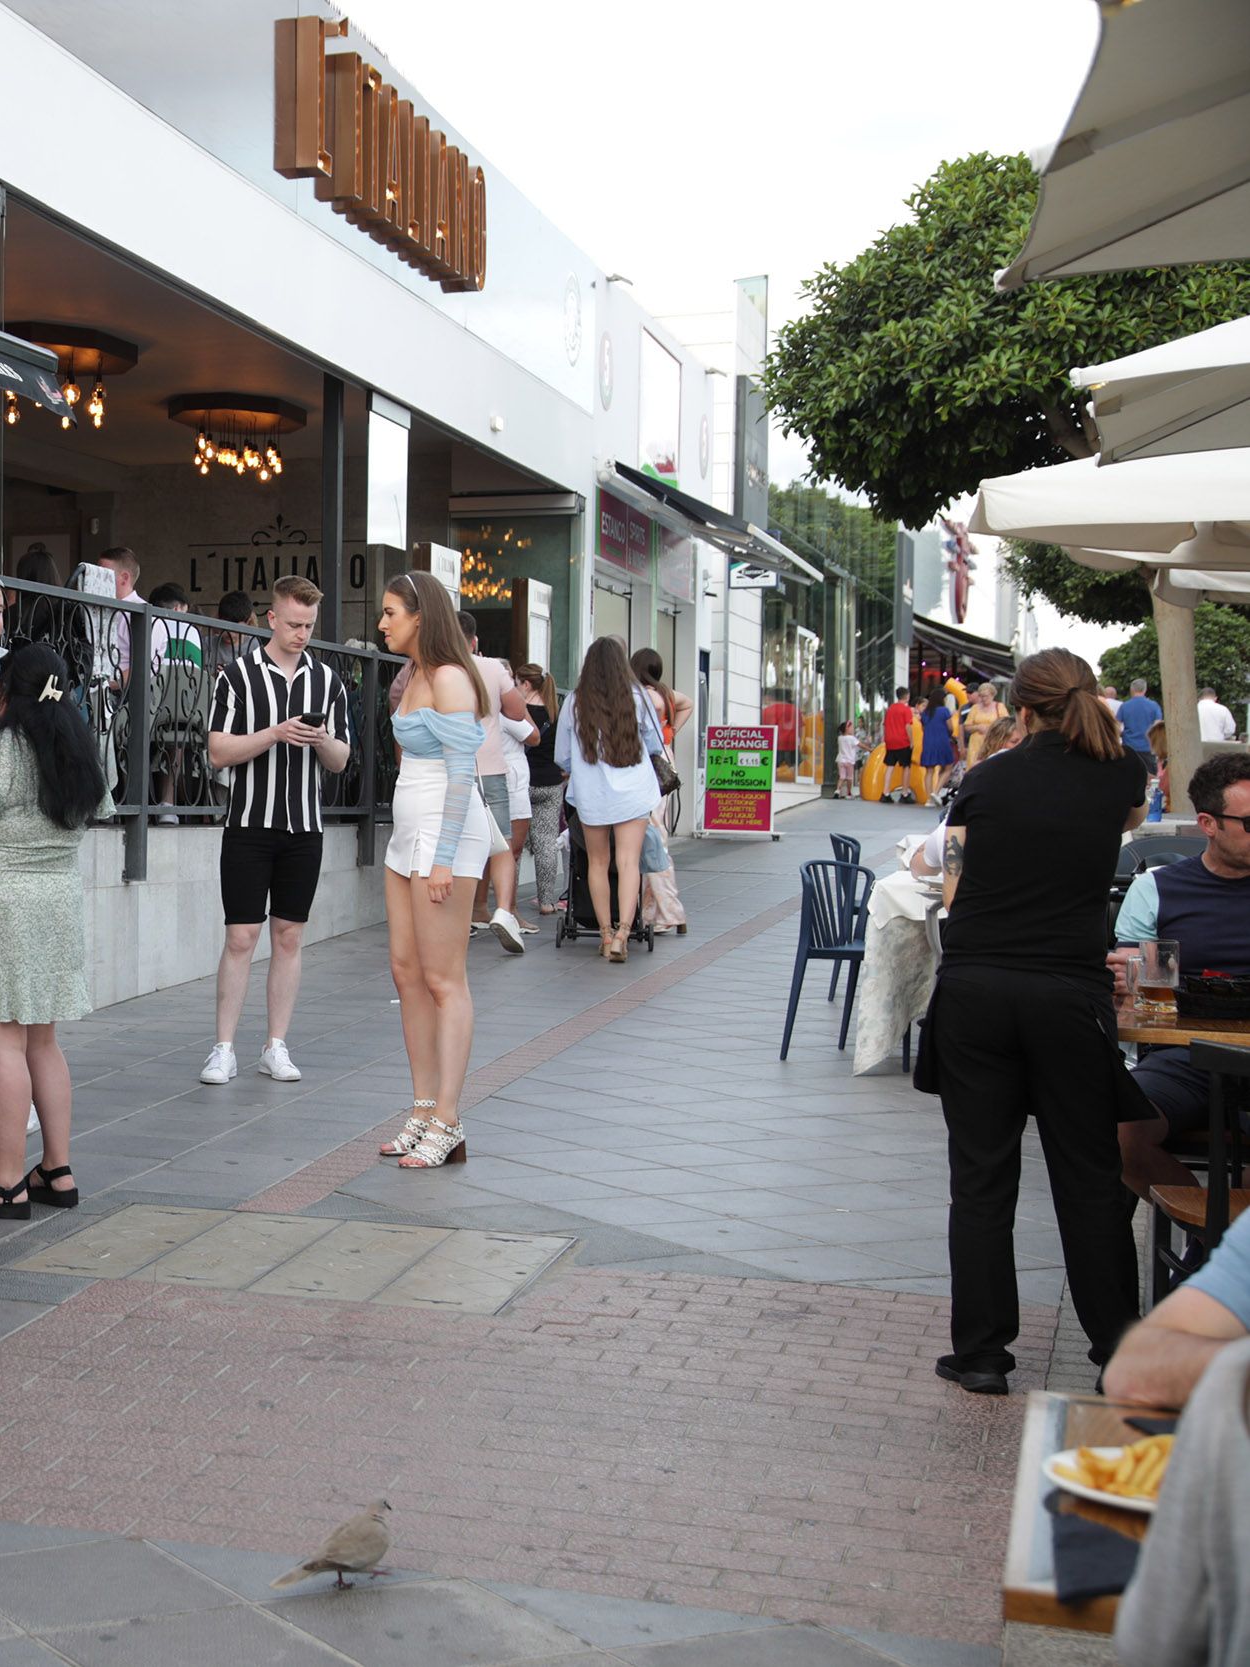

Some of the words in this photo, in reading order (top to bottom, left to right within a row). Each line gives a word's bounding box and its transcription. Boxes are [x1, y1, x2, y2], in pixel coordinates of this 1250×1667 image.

[601, 511, 625, 544] ESTANCO
[715, 729, 764, 739] OFFICIAL
[710, 739, 769, 749] EXCHANGE
[761, 756, 769, 766] €
[709, 778, 767, 787] COMMISSION
